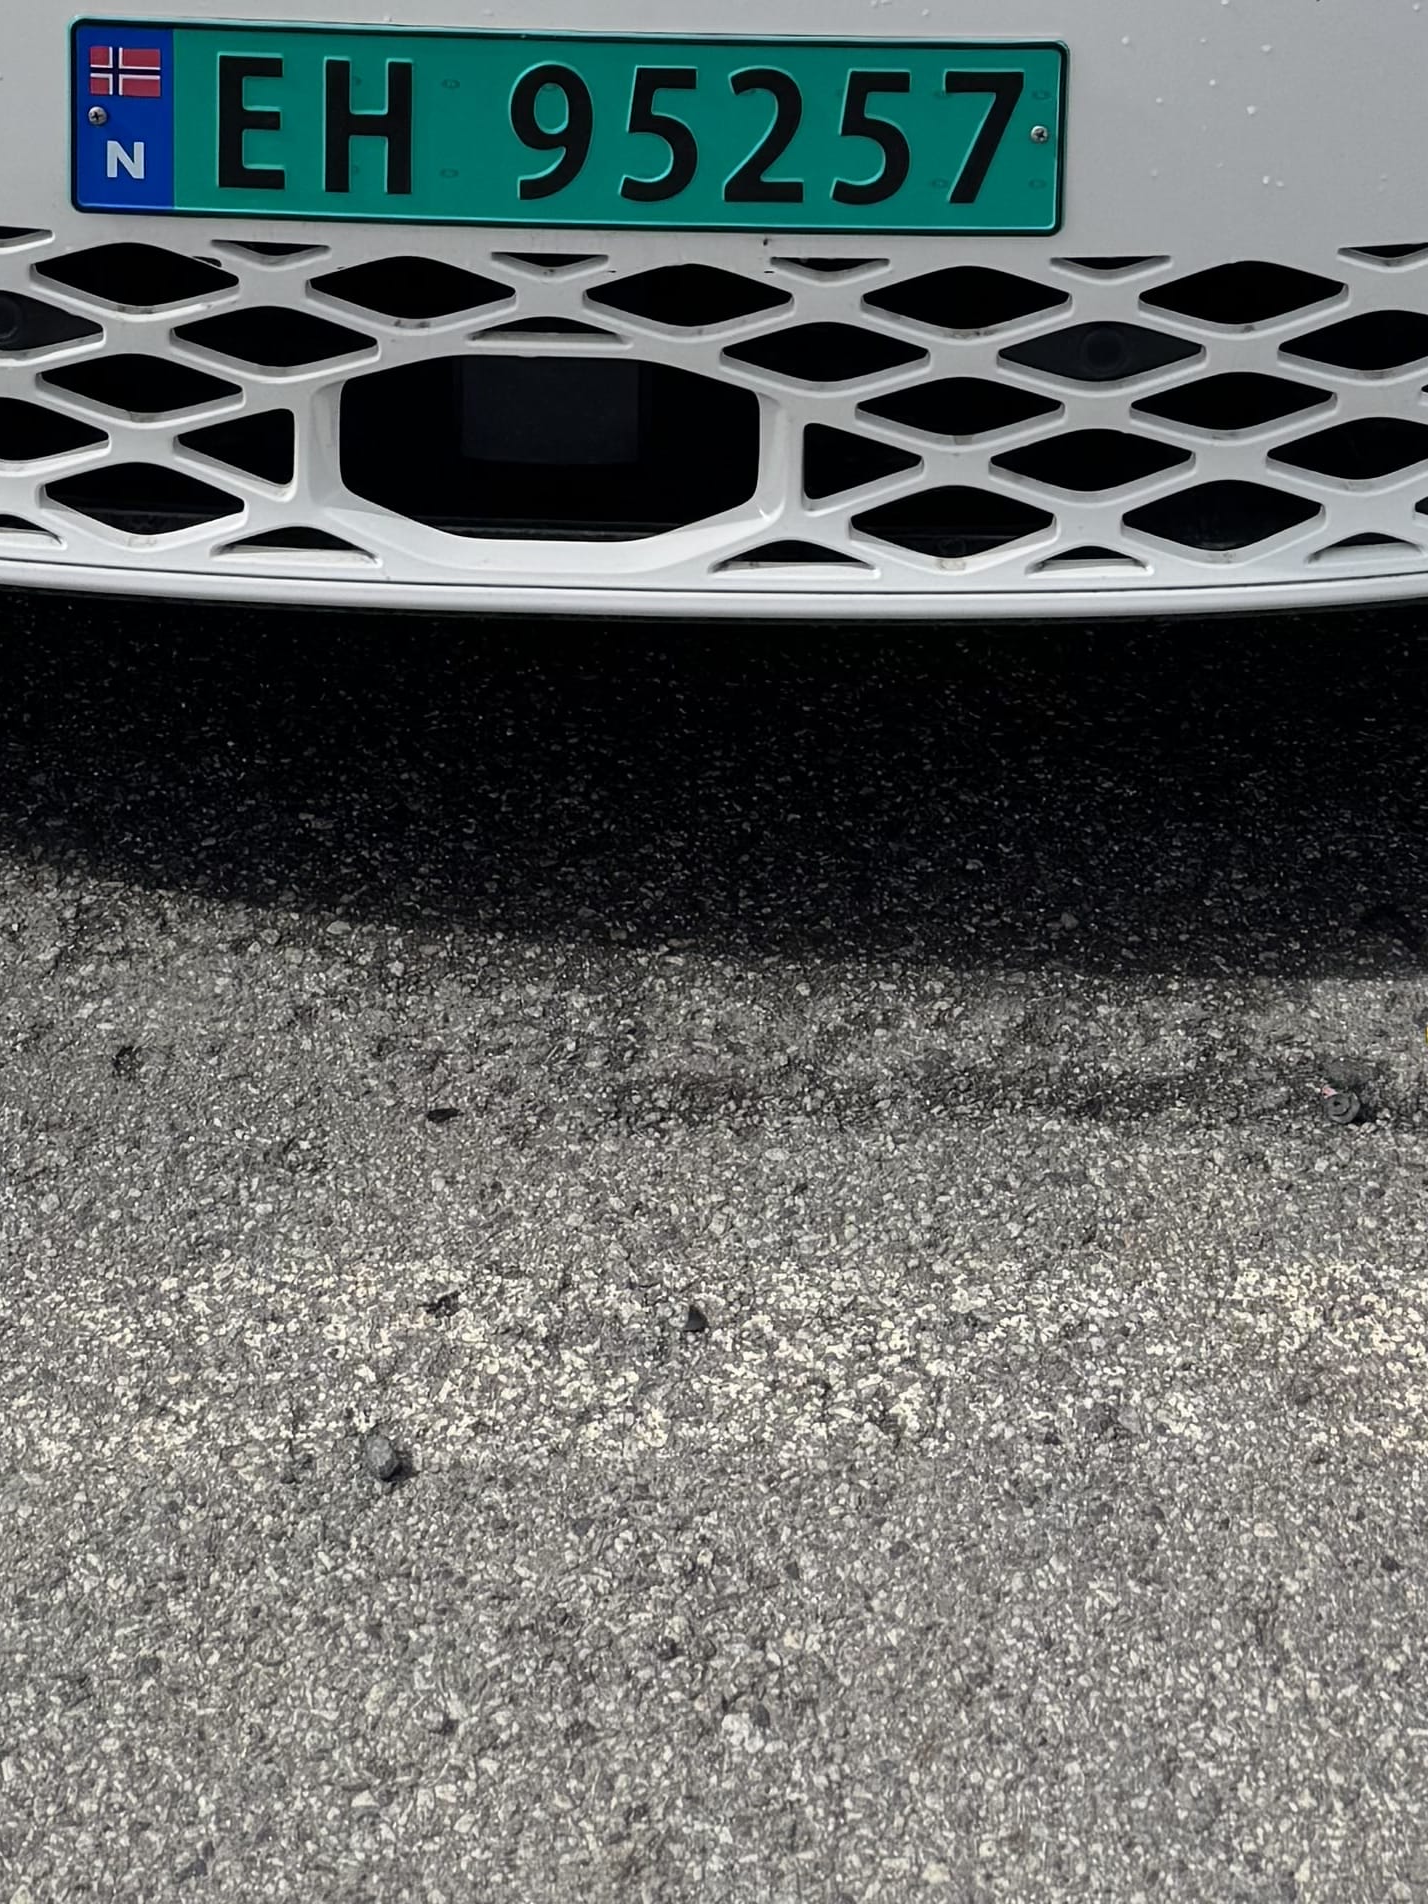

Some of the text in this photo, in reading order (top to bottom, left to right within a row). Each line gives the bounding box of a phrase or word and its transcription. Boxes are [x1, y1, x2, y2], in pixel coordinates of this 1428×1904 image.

[104, 138, 147, 180] N
[216, 50, 1026, 206] EH 95257
